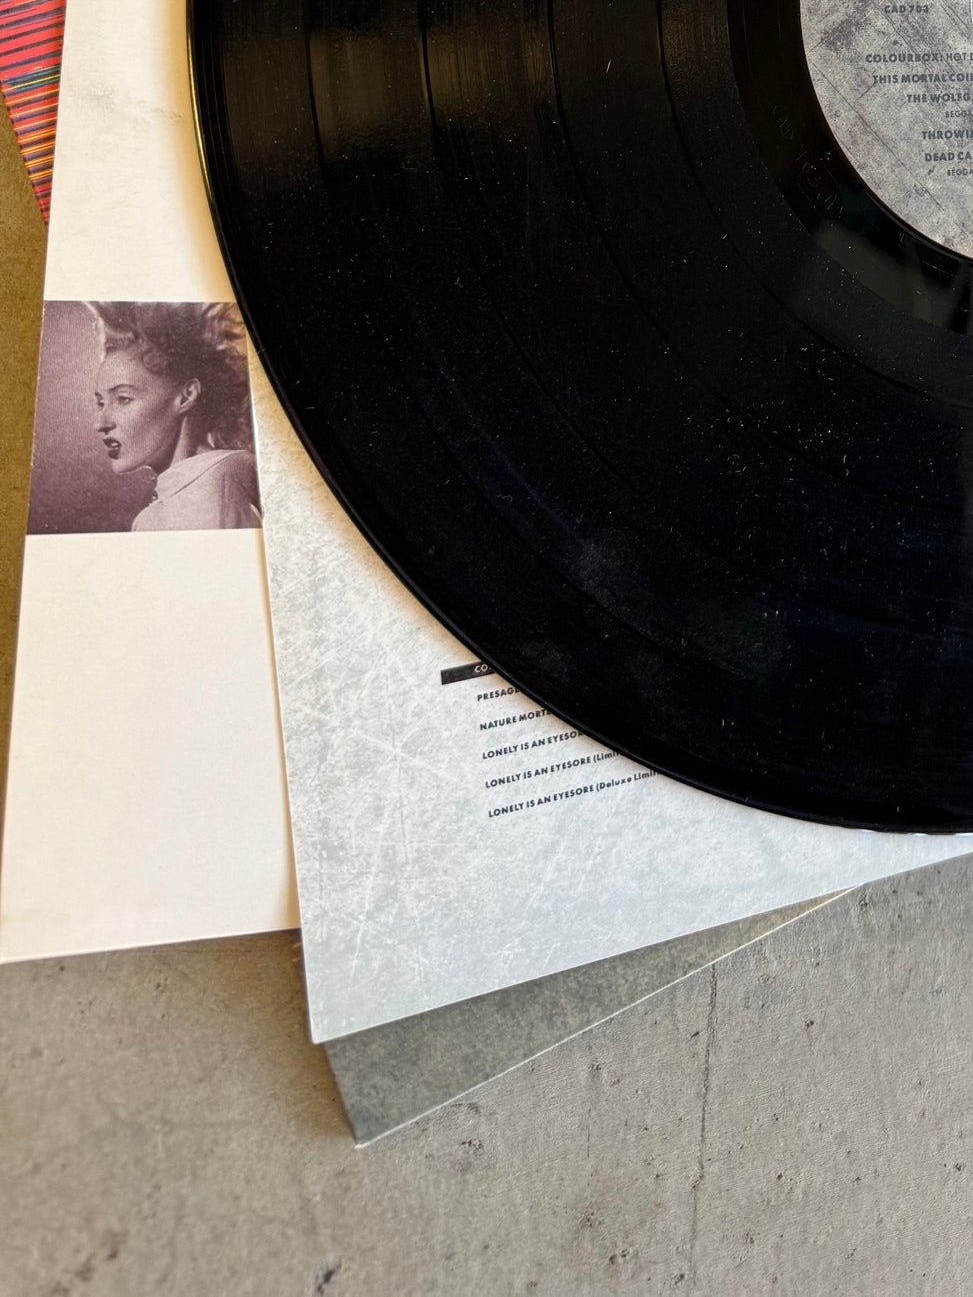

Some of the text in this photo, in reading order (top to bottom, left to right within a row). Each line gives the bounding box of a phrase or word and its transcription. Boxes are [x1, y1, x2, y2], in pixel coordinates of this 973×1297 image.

[884, 4, 929, 14] CAD 703
[865, 52, 944, 64] COLOURBOX:
[946, 52, 968, 62] HOT
[873, 73, 899, 85] THIS
[901, 72, 948, 84] MORTAL
[907, 93, 929, 104] THE
[925, 152, 955, 162] DEAD
[474, 663, 492, 674] CO
[480, 715, 517, 732] NATURE
[482, 744, 519, 760] LONELY
[520, 741, 530, 751] IS
[531, 737, 546, 749] AN
[485, 773, 521, 789] LONELY
[523, 769, 533, 780] IS
[534, 766, 549, 778] AN
[550, 756, 592, 774] EYESORE
[488, 802, 524, 818] LONELY
[526, 798, 536, 809] IS
[537, 795, 552, 807] AN
[553, 784, 595, 802] EYESORE
[595, 777, 633, 792] (Deluxe
